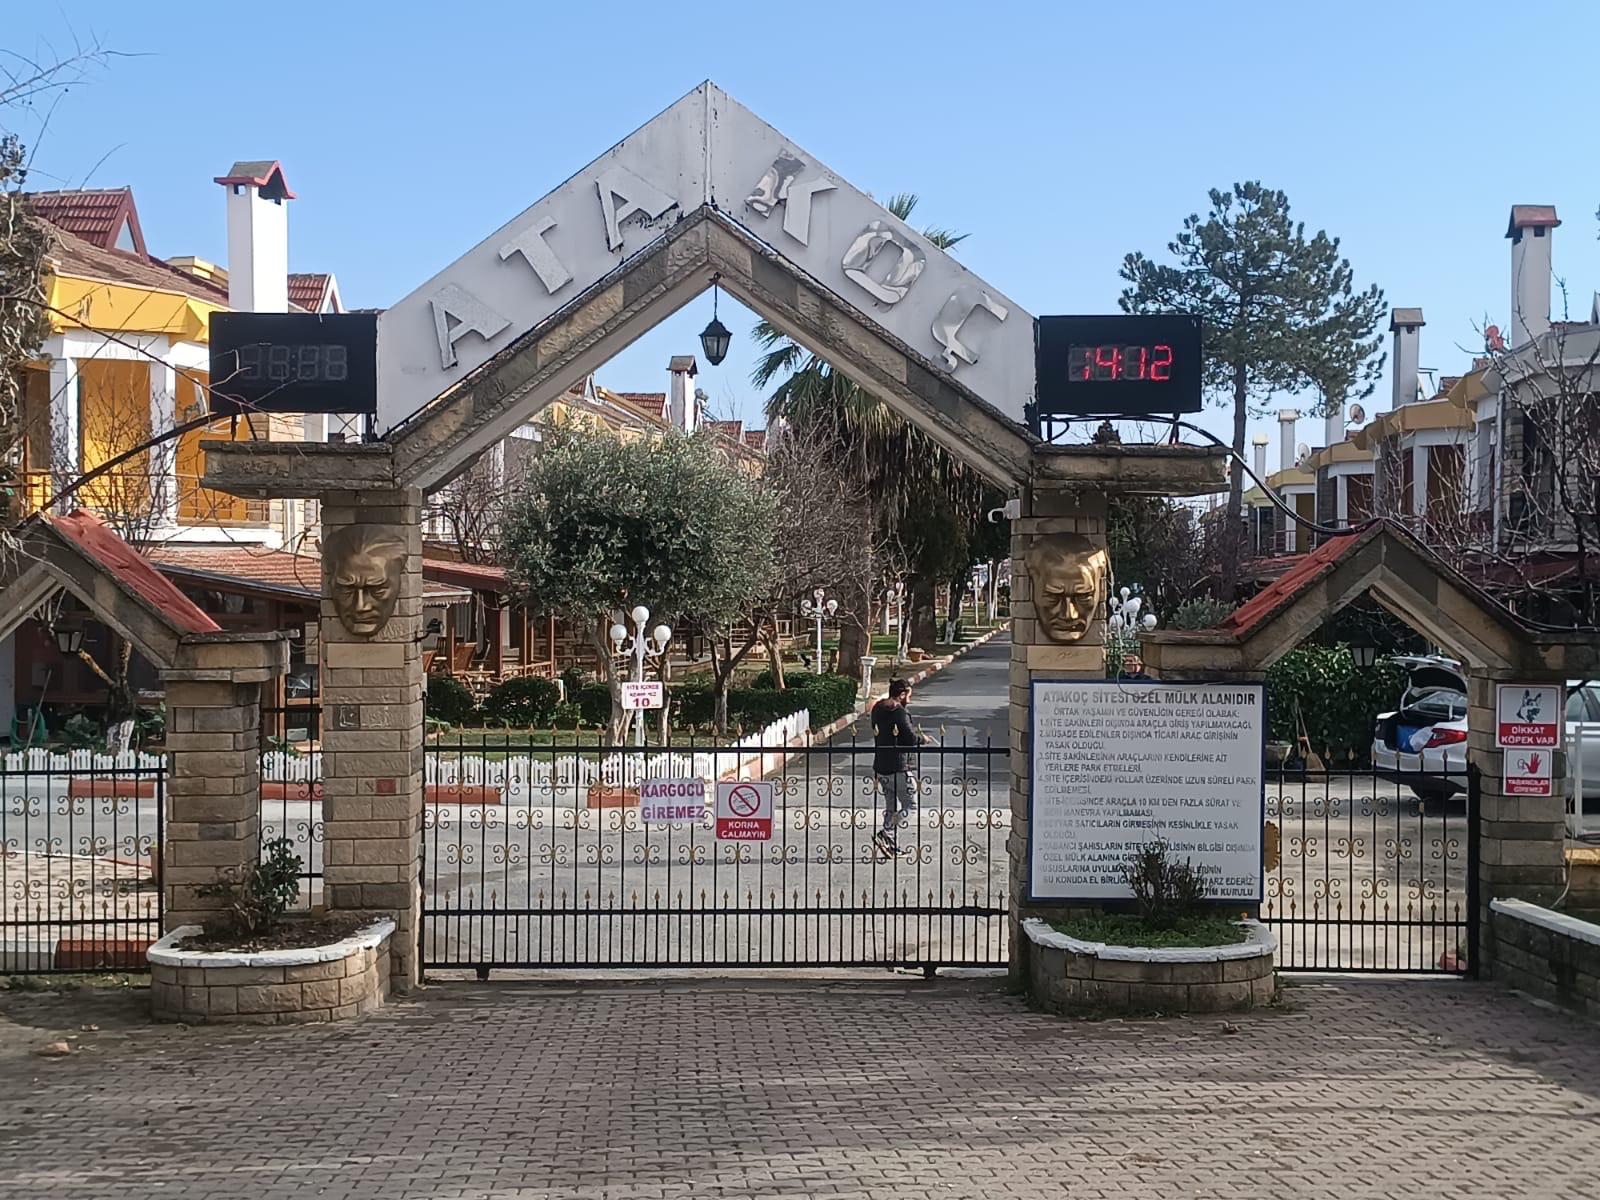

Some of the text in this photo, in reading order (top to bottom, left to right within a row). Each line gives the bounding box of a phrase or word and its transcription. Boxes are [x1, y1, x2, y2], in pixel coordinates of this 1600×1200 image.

[1083, 344, 1172, 380] 14:12
[1092, 690, 1129, 704] SİTESİ
[1132, 690, 1161, 704] ÖZEL
[1165, 690, 1198, 704] MÜLK
[1201, 692, 1255, 705] ALANIDIR
[633, 698, 650, 707] 10
[1054, 708, 1080, 716] ORTAK
[1136, 719, 1168, 729] ARAÇLA
[1169, 719, 1190, 730] GİRİŞ
[1154, 730, 1178, 739] TİCARİ
[1512, 725, 1545, 735] DİKKAT
[1501, 735, 1555, 744] KÖPEK VAR
[1045, 741, 1070, 749] YASAK
[1045, 764, 1079, 772] YERLERE
[1080, 764, 1101, 772] PARK
[1114, 776, 1144, 784] YOLLAR
[1146, 774, 1184, 784] ÜZERİNDE
[1185, 776, 1206, 784] UZUN
[1208, 775, 1234, 784] SÜRELİ
[641, 784, 704, 798] KARGOCU
[1106, 797, 1136, 806] ARAÇLA
[1180, 798, 1203, 807] FAZLA
[1205, 798, 1230, 808] SÜRAT
[642, 804, 704, 820] GİREMEZ
[728, 821, 760, 829] KORNA
[1214, 821, 1239, 830] YASAK
[1124, 842, 1140, 850] SİTE
[1056, 876, 1088, 884] KONUDA
[1089, 876, 1099, 884] EL
[1220, 888, 1253, 896] KURULU
